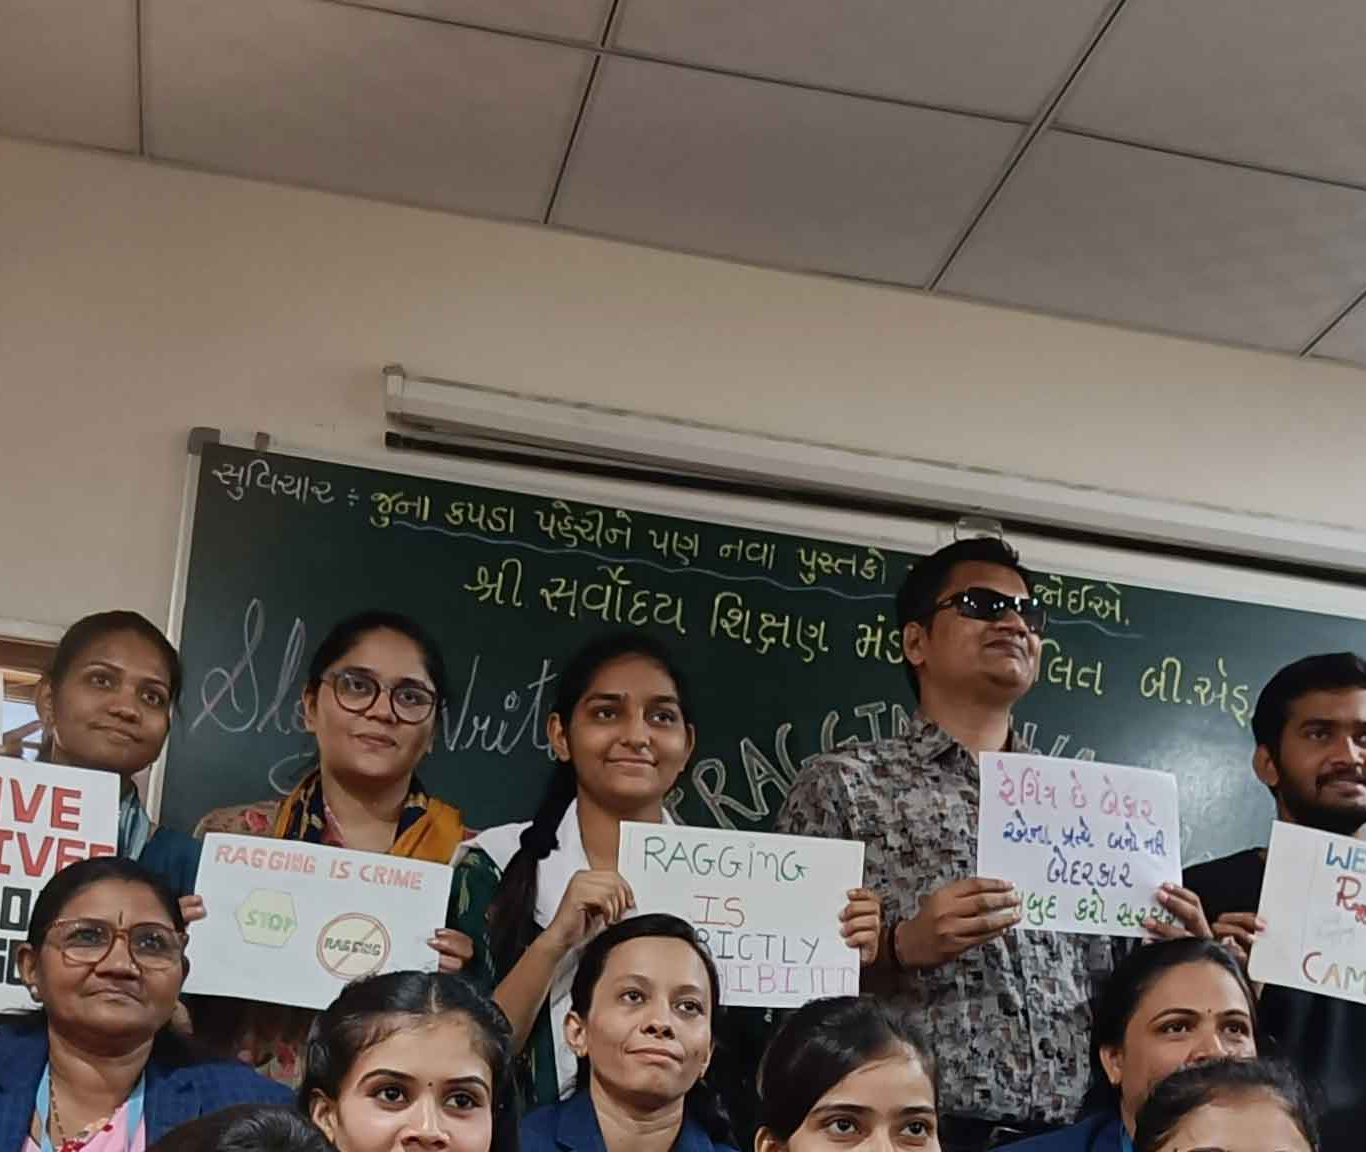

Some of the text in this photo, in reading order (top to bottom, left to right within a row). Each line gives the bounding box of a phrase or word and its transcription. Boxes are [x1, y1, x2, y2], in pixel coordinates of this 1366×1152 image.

[649, 529, 699, 565] પણ
[719, 542, 775, 569] નવા
[462, 558, 522, 608] શ્રી
[215, 843, 425, 891] RAGGING IS CRIME
[693, 894, 746, 928] IS
